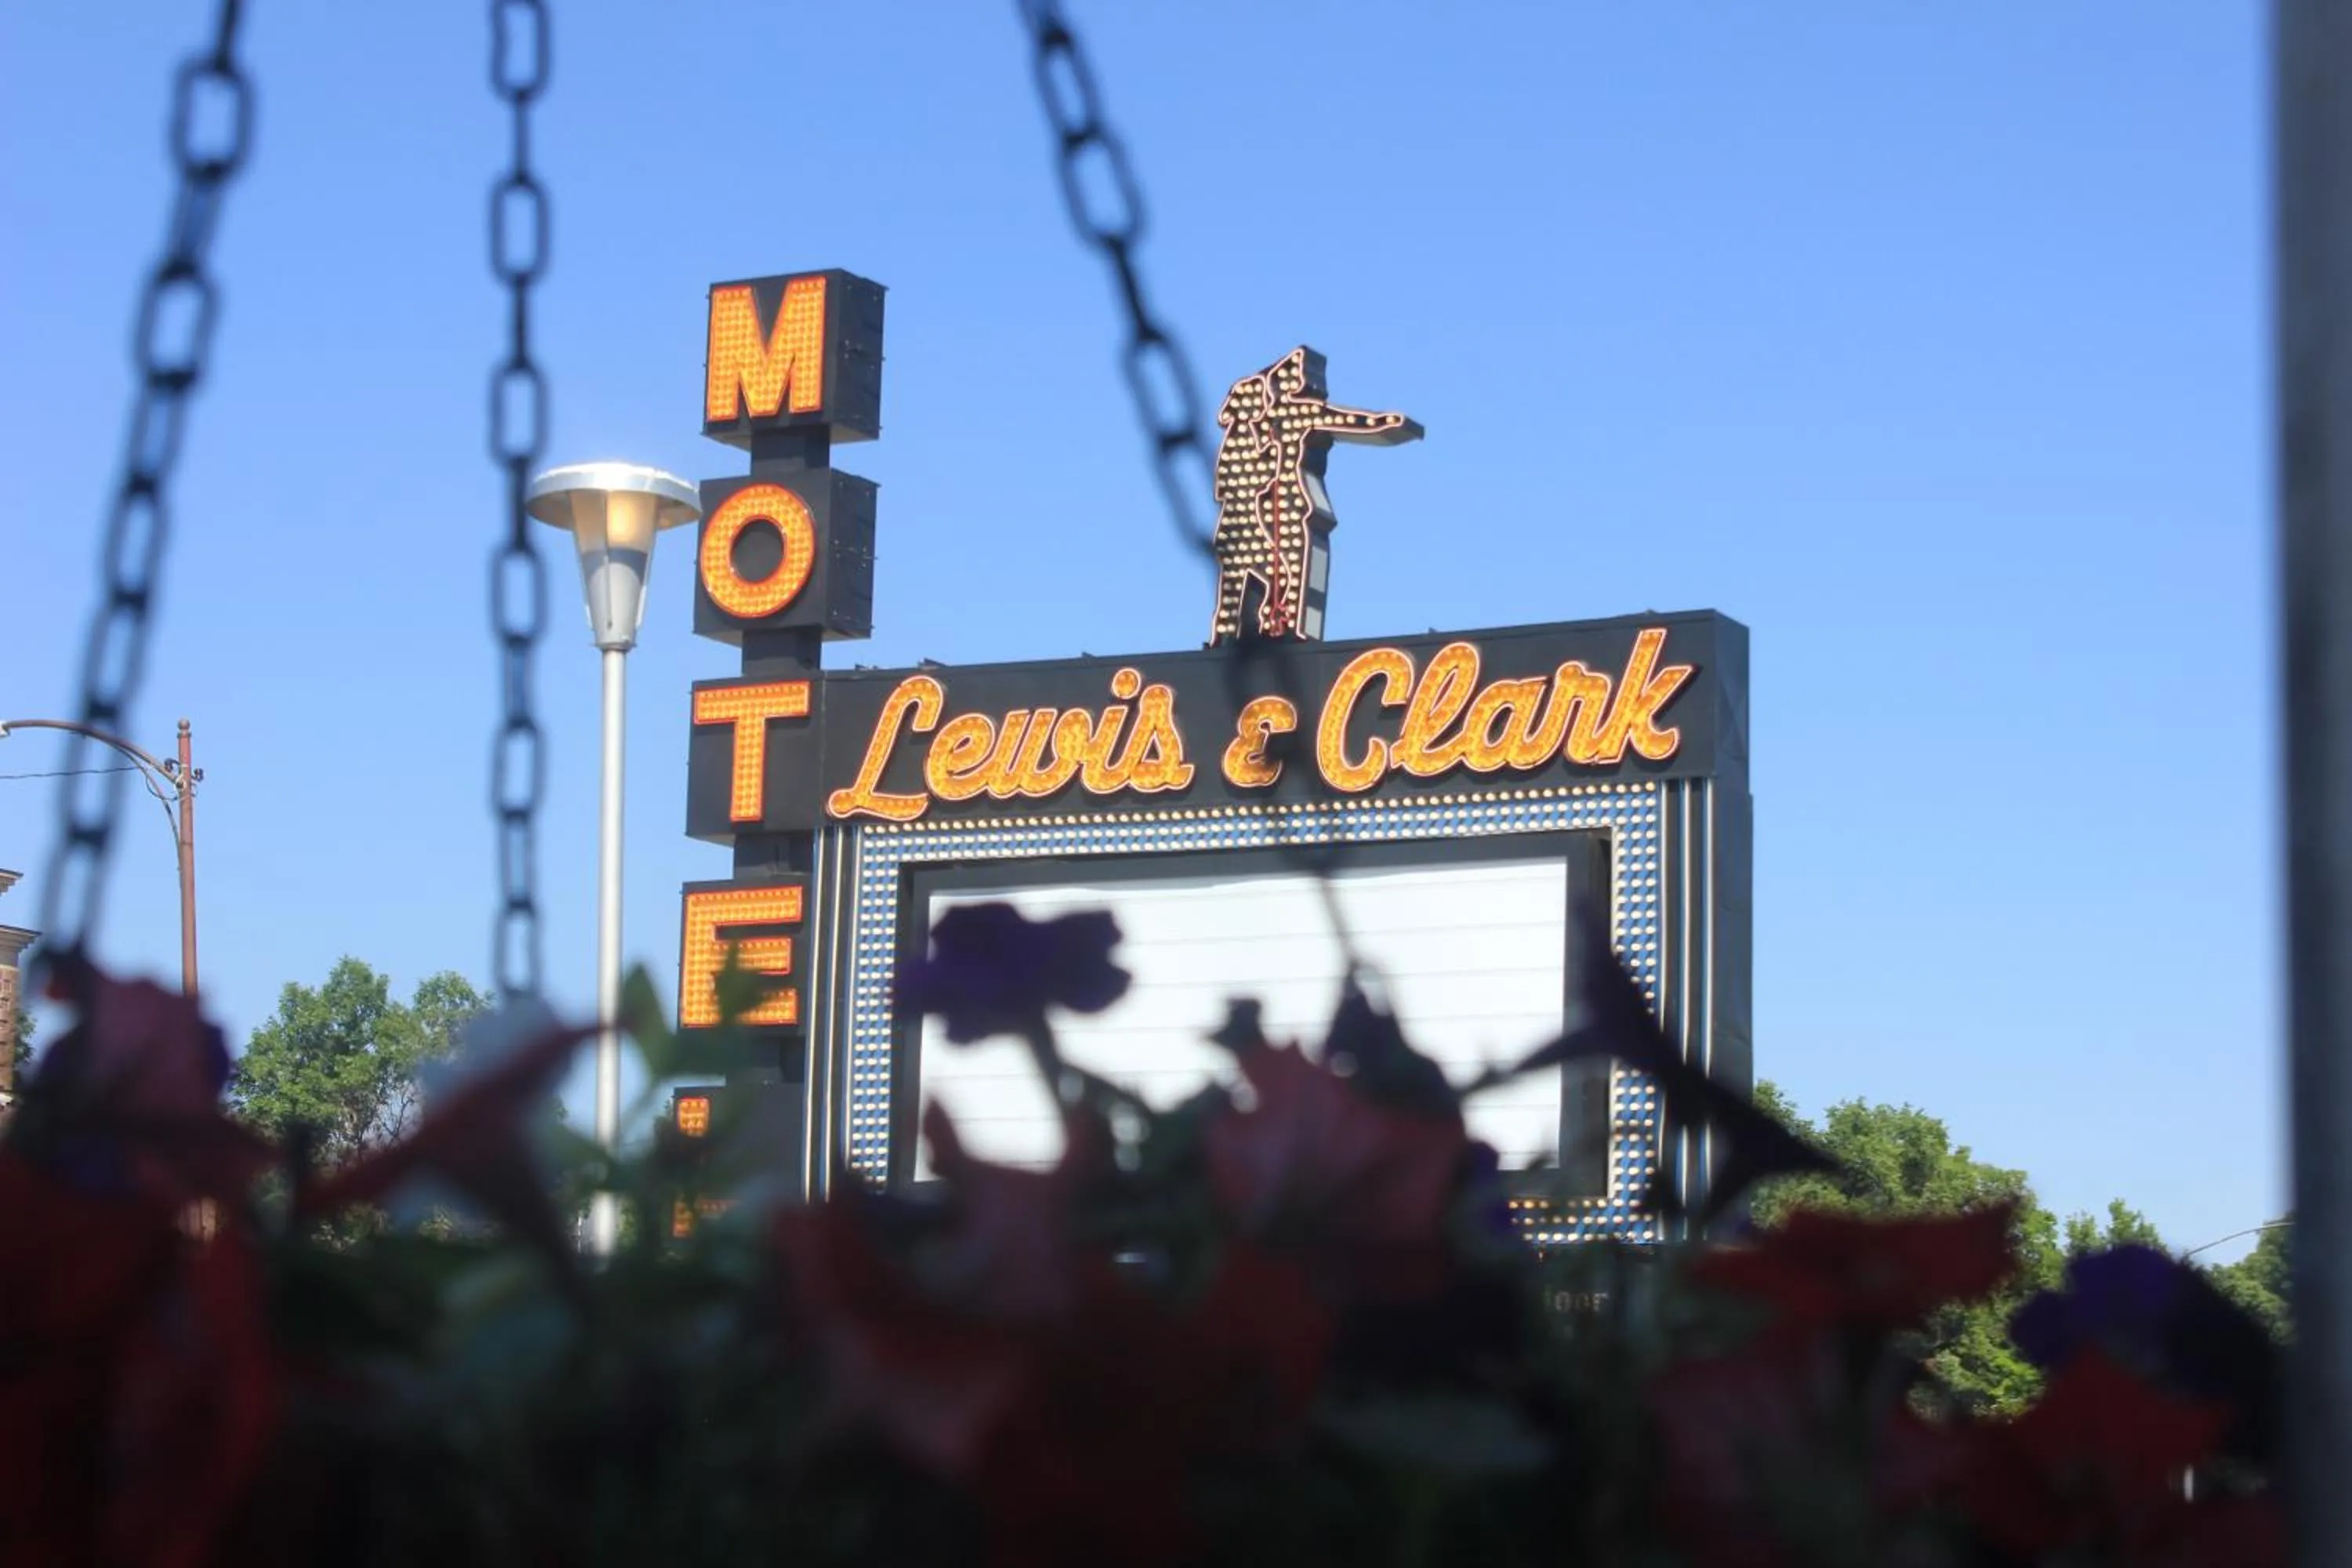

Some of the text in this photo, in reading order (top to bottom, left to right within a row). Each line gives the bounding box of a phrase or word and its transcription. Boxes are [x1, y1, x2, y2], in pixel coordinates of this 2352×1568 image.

[672, 275, 826, 1239] MOTE
[826, 628, 1694, 821] Lewis & Clark
